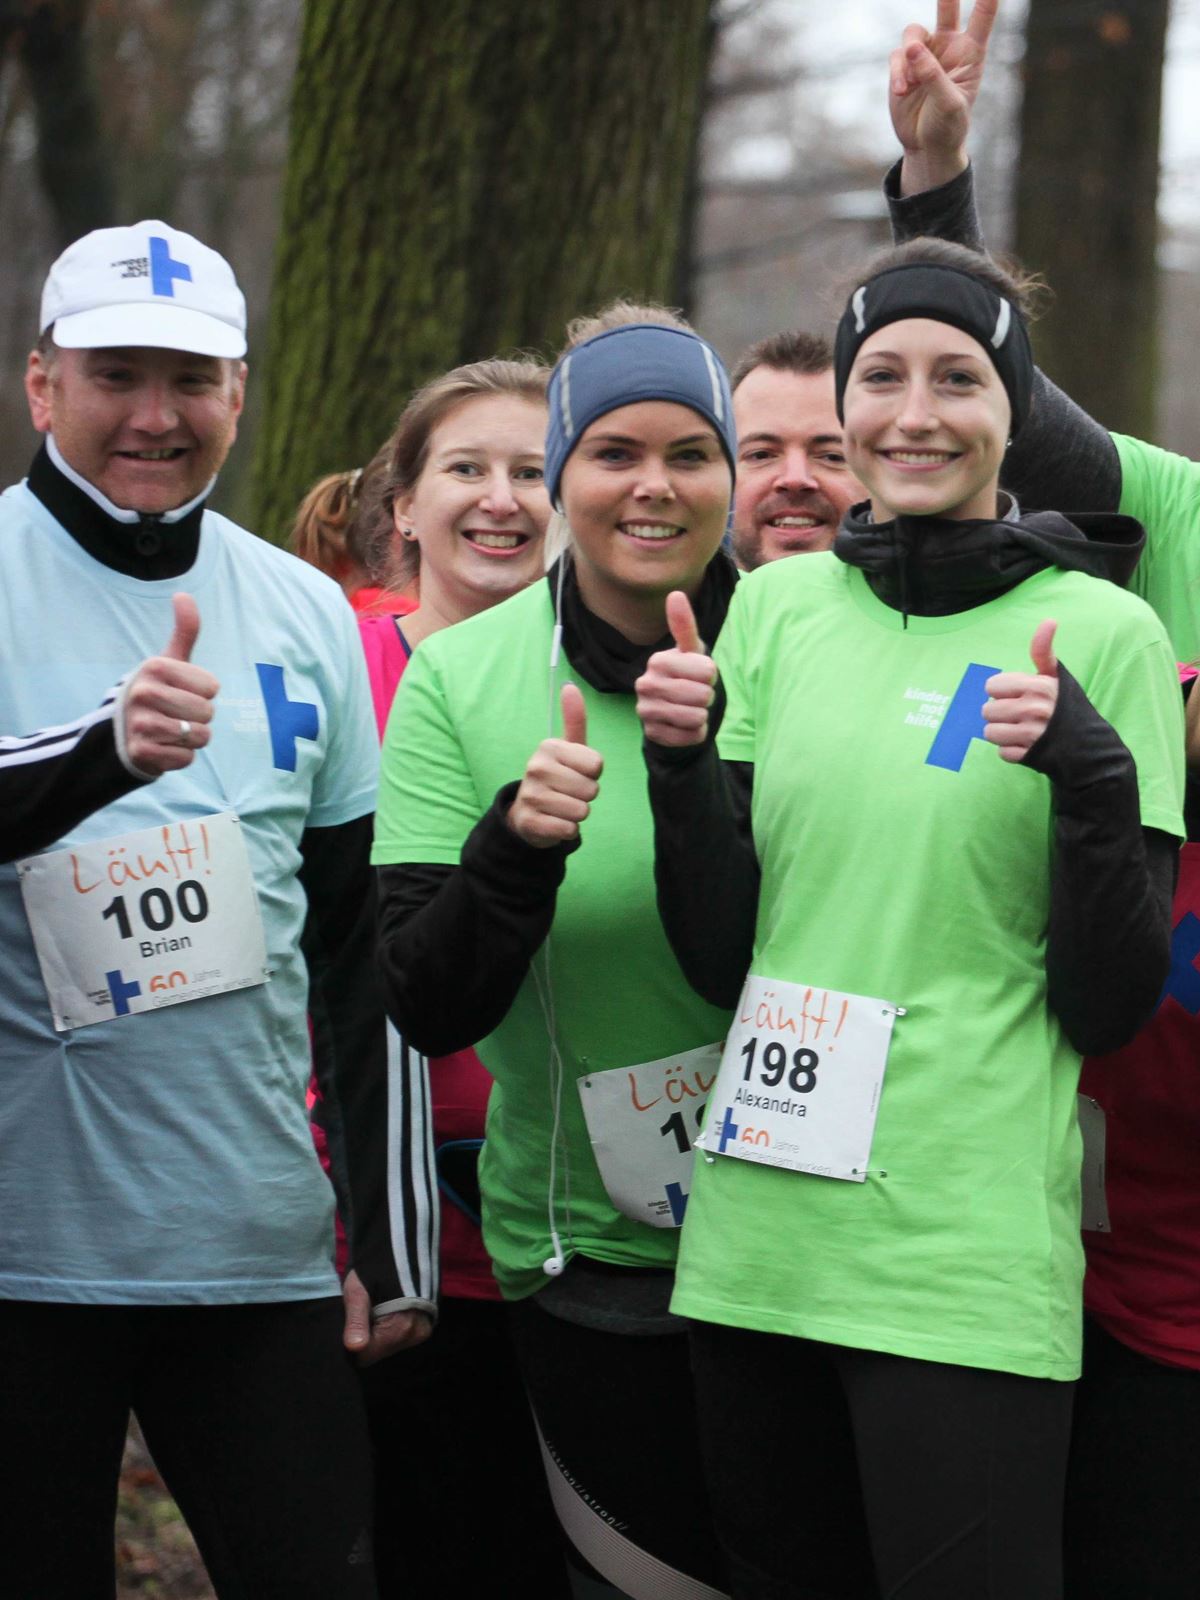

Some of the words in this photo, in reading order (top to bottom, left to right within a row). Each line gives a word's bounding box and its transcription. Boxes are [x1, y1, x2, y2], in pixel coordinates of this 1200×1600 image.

[70, 823, 213, 895] Läuft!
[102, 880, 209, 939] 100
[140, 935, 192, 958] Brian
[741, 1037, 819, 1093] 198
[734, 1087, 807, 1117] Alexandra
